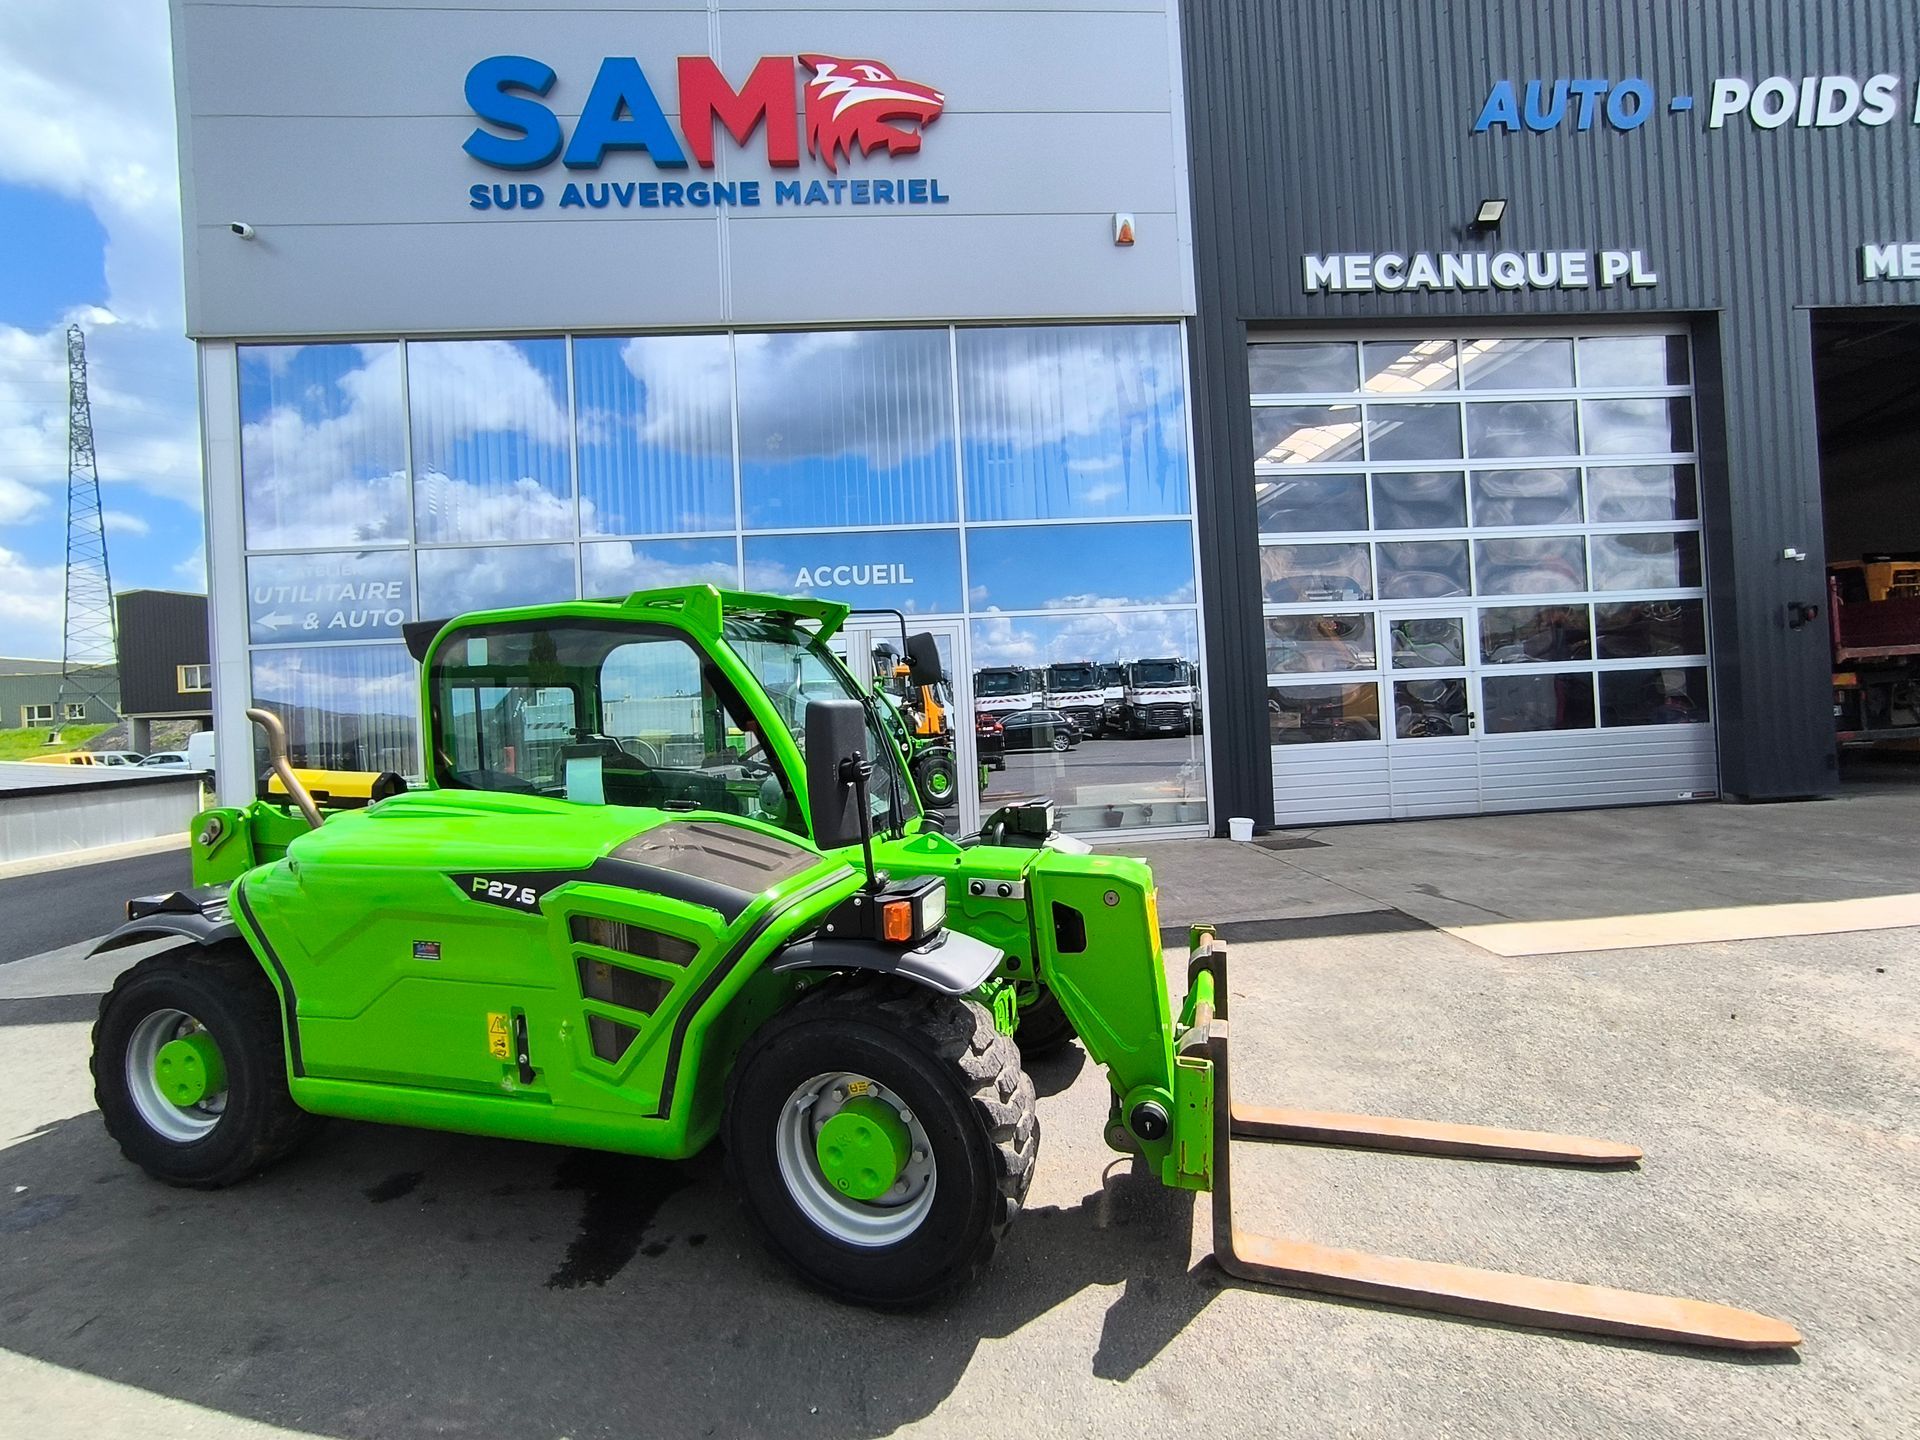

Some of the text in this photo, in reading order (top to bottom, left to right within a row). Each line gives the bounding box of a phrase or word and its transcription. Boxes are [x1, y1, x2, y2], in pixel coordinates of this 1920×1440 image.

[462, 55, 799, 170] SAM
[1474, 78, 1653, 131] AUTO
[1710, 74, 1899, 129] POIDS
[469, 178, 949, 210] SUD AUVERGNE MATERIEL
[1303, 250, 1657, 293] MECANIQUE PL
[795, 564, 914, 587] ACCUEIL
[254, 581, 403, 604] UTILITAIRE
[303, 609, 405, 630] & AUTO
[472, 877, 536, 905] P27.6
